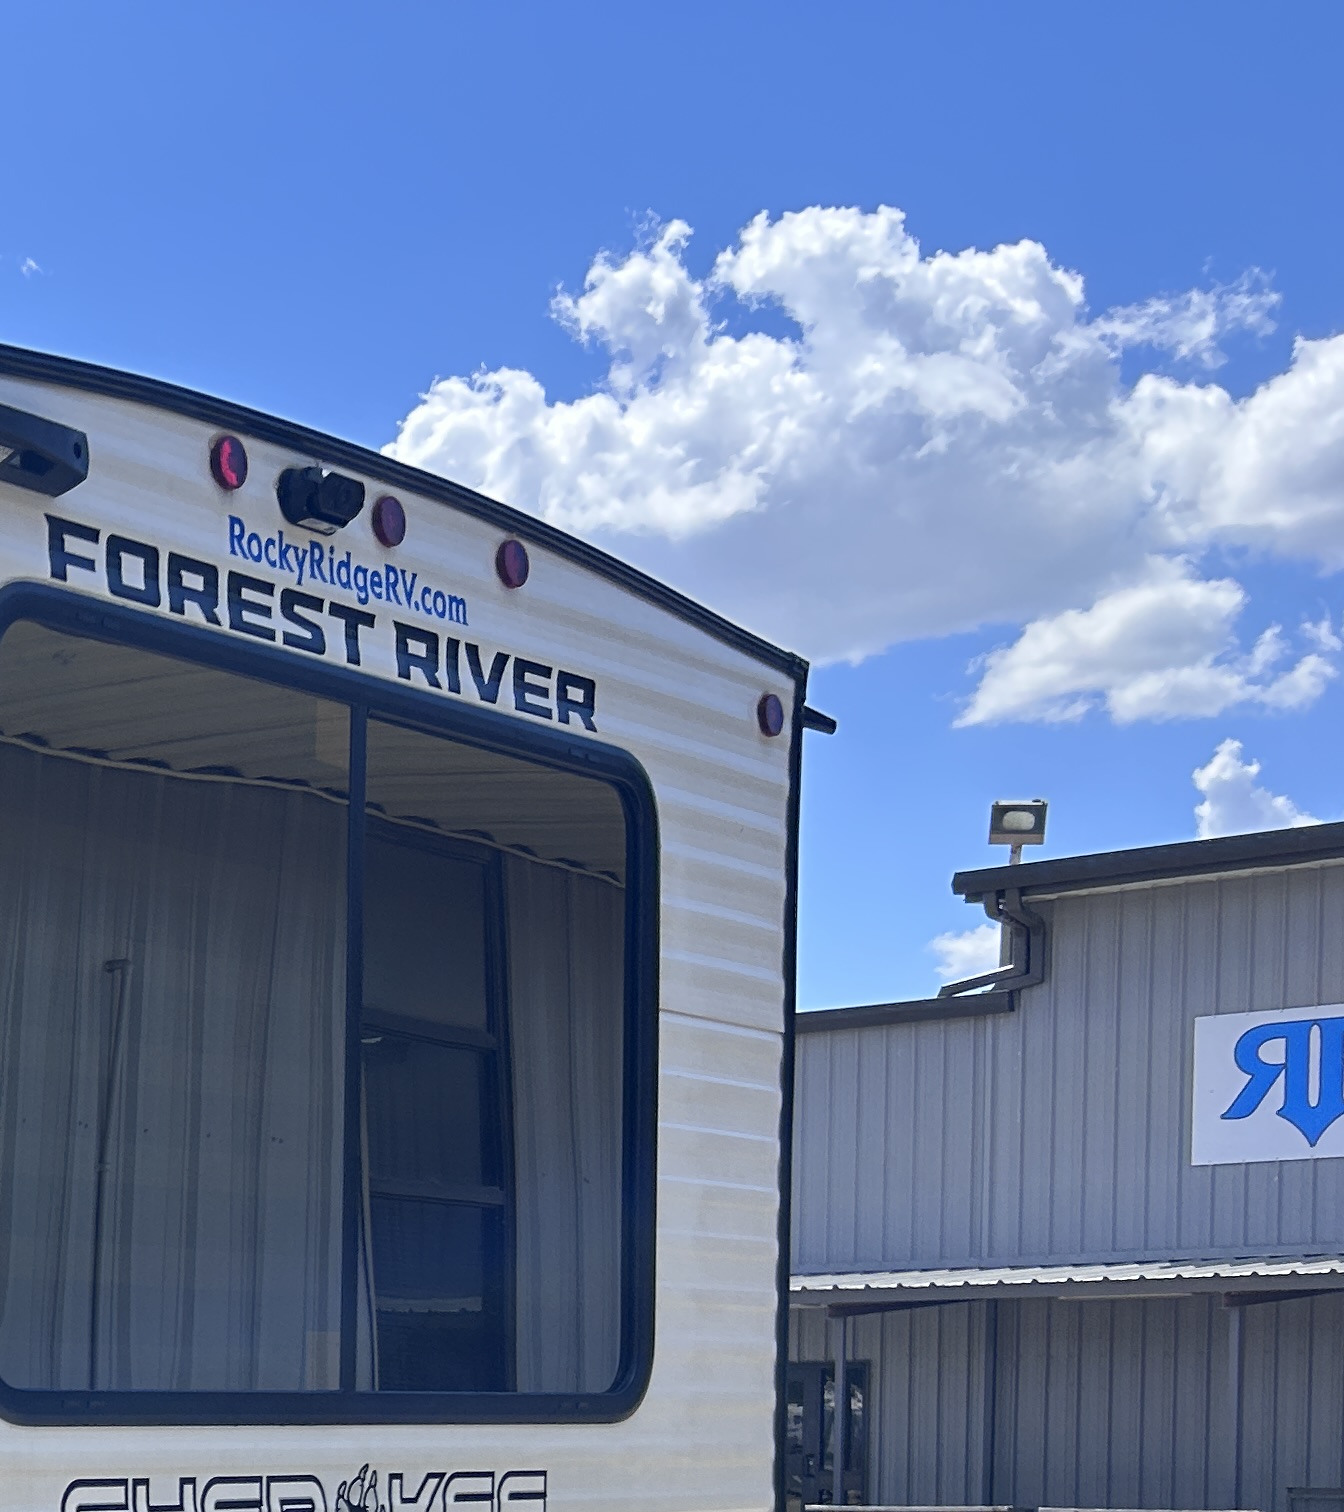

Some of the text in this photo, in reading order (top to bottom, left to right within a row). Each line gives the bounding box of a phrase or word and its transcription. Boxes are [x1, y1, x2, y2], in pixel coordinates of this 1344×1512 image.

[43, 512, 599, 733] FOREST RIVER
[227, 514, 469, 627] RockyRidgeRV.com
